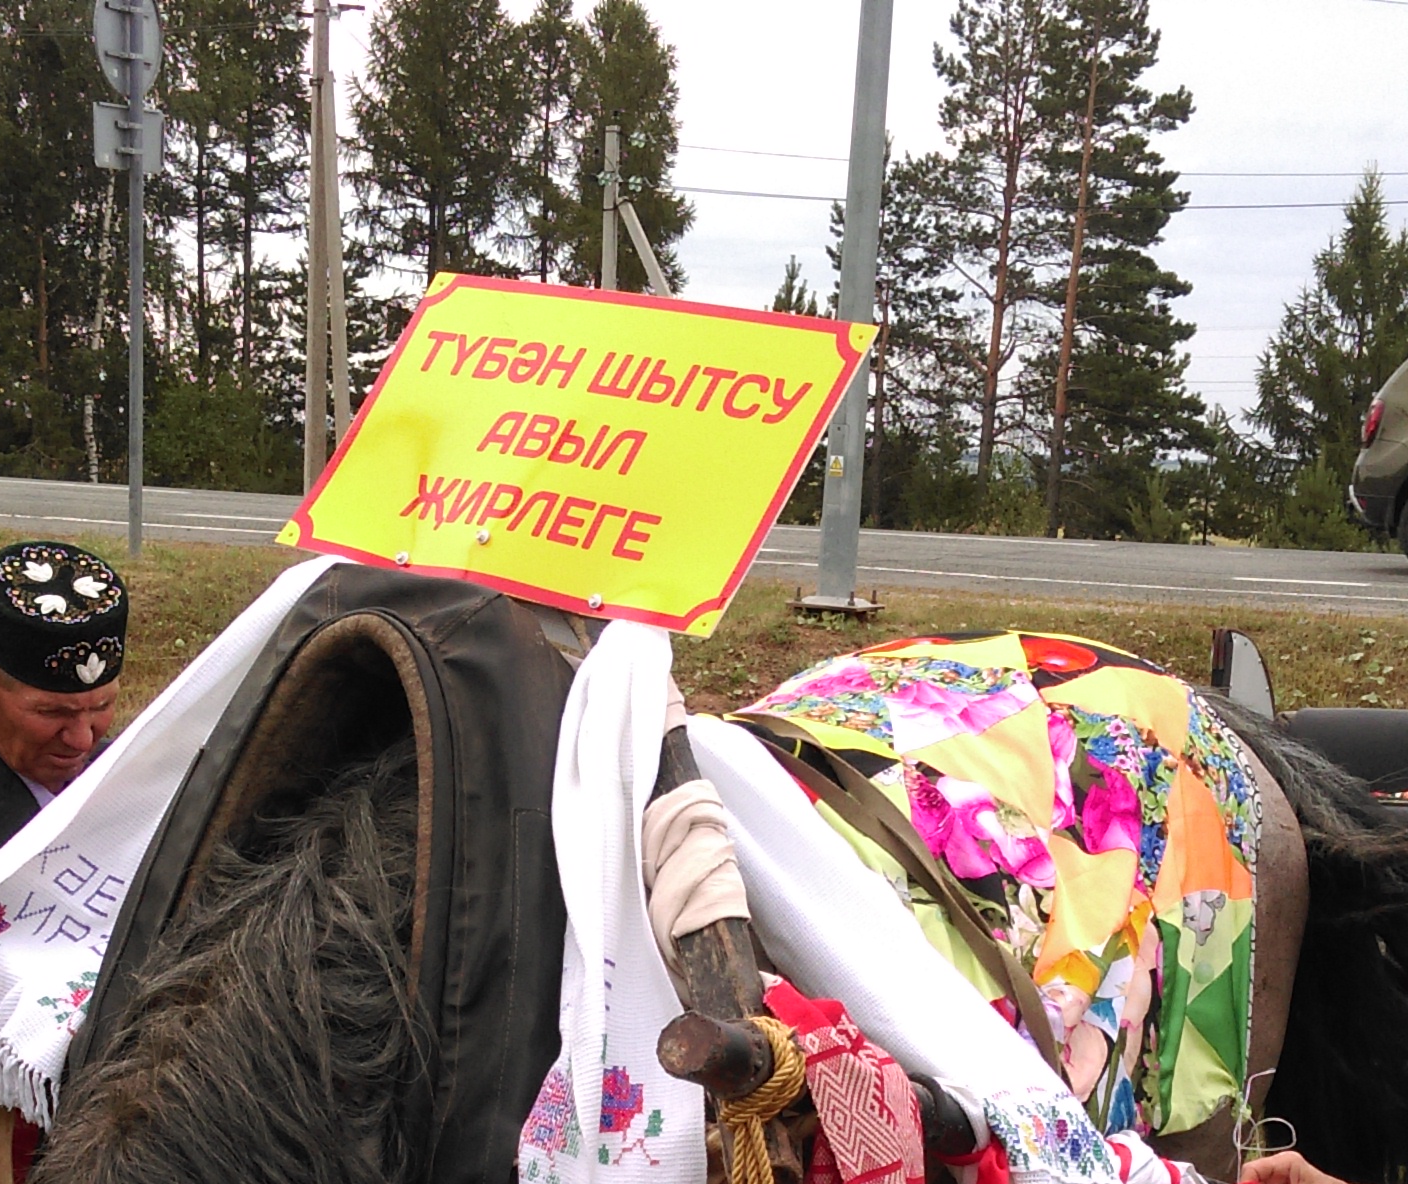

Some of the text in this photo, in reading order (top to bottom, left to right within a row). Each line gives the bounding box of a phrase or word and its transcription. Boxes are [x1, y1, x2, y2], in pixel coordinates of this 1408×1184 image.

[420, 330, 813, 425] ТҮБӘН ШЫТСУ
[476, 410, 648, 476] АВЫЛ
[399, 473, 663, 562] ҖИРЛЕГЕ
